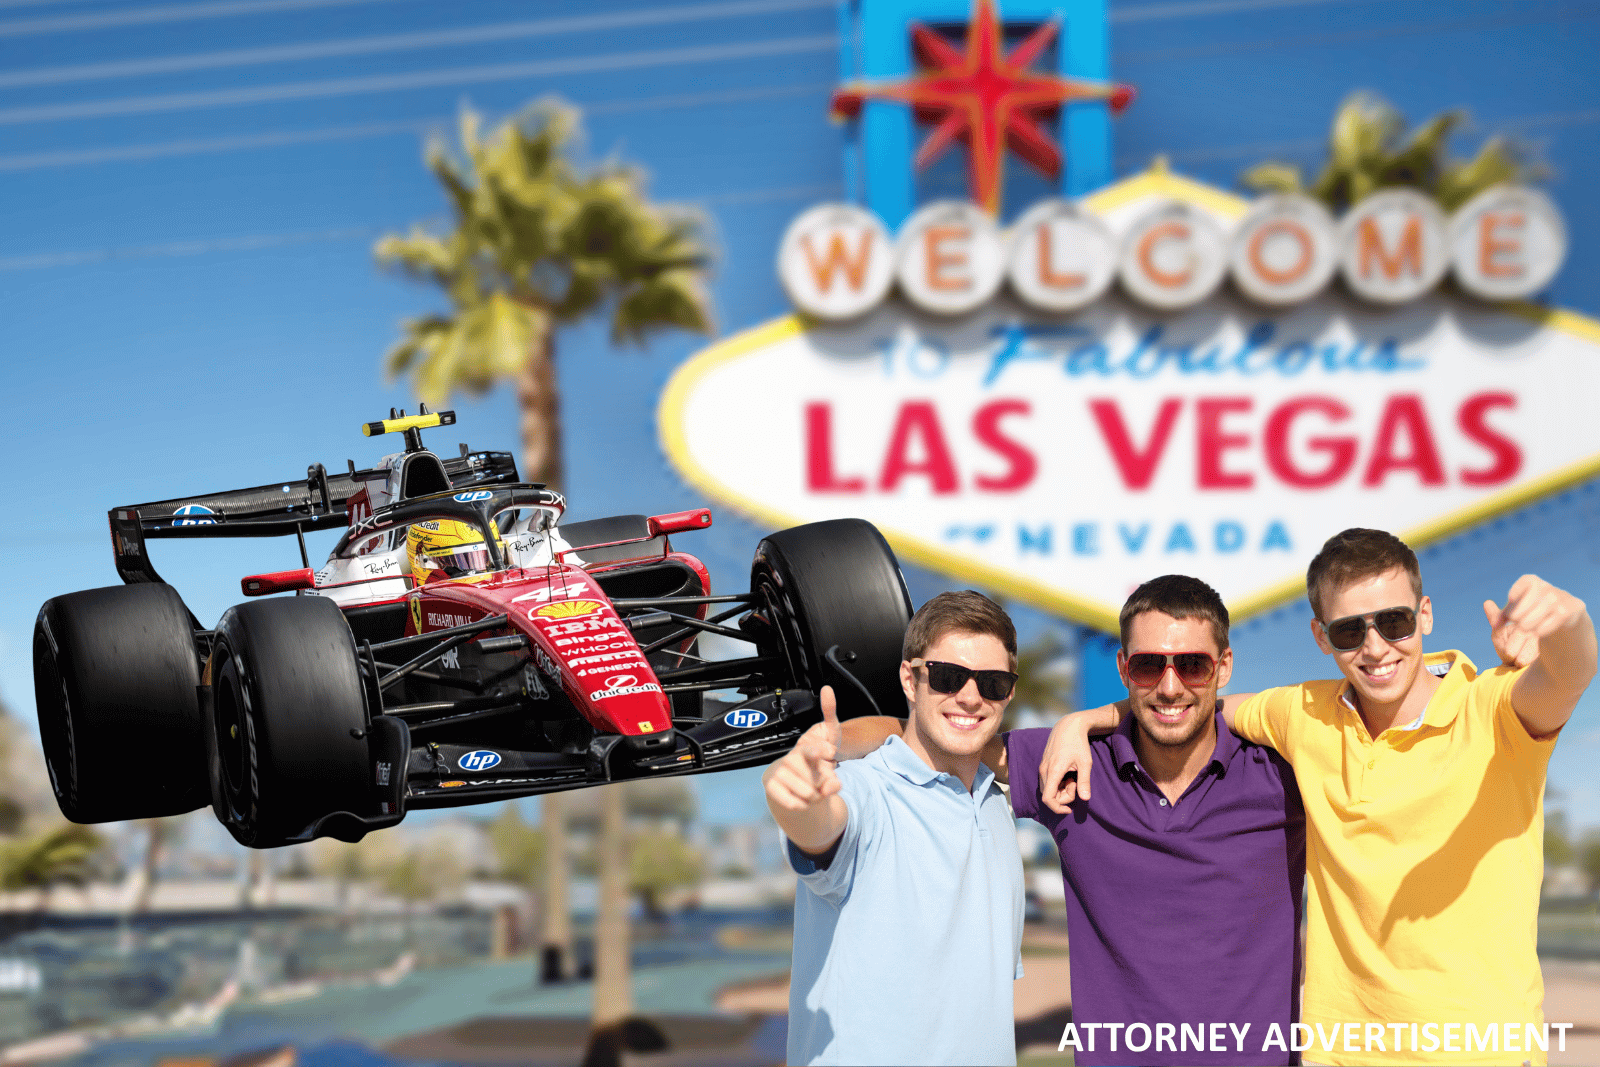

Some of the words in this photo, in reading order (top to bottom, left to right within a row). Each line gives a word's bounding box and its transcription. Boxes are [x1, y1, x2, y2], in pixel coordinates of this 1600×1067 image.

[800, 210, 1530, 294] WELCOME
[803, 398, 1041, 496] LAS
[1088, 391, 1526, 491] VEGAS
[1017, 519, 1293, 556] NEVADA
[511, 582, 590, 603] 44
[427, 612, 454, 628] RICHARD
[543, 616, 623, 638] IBM
